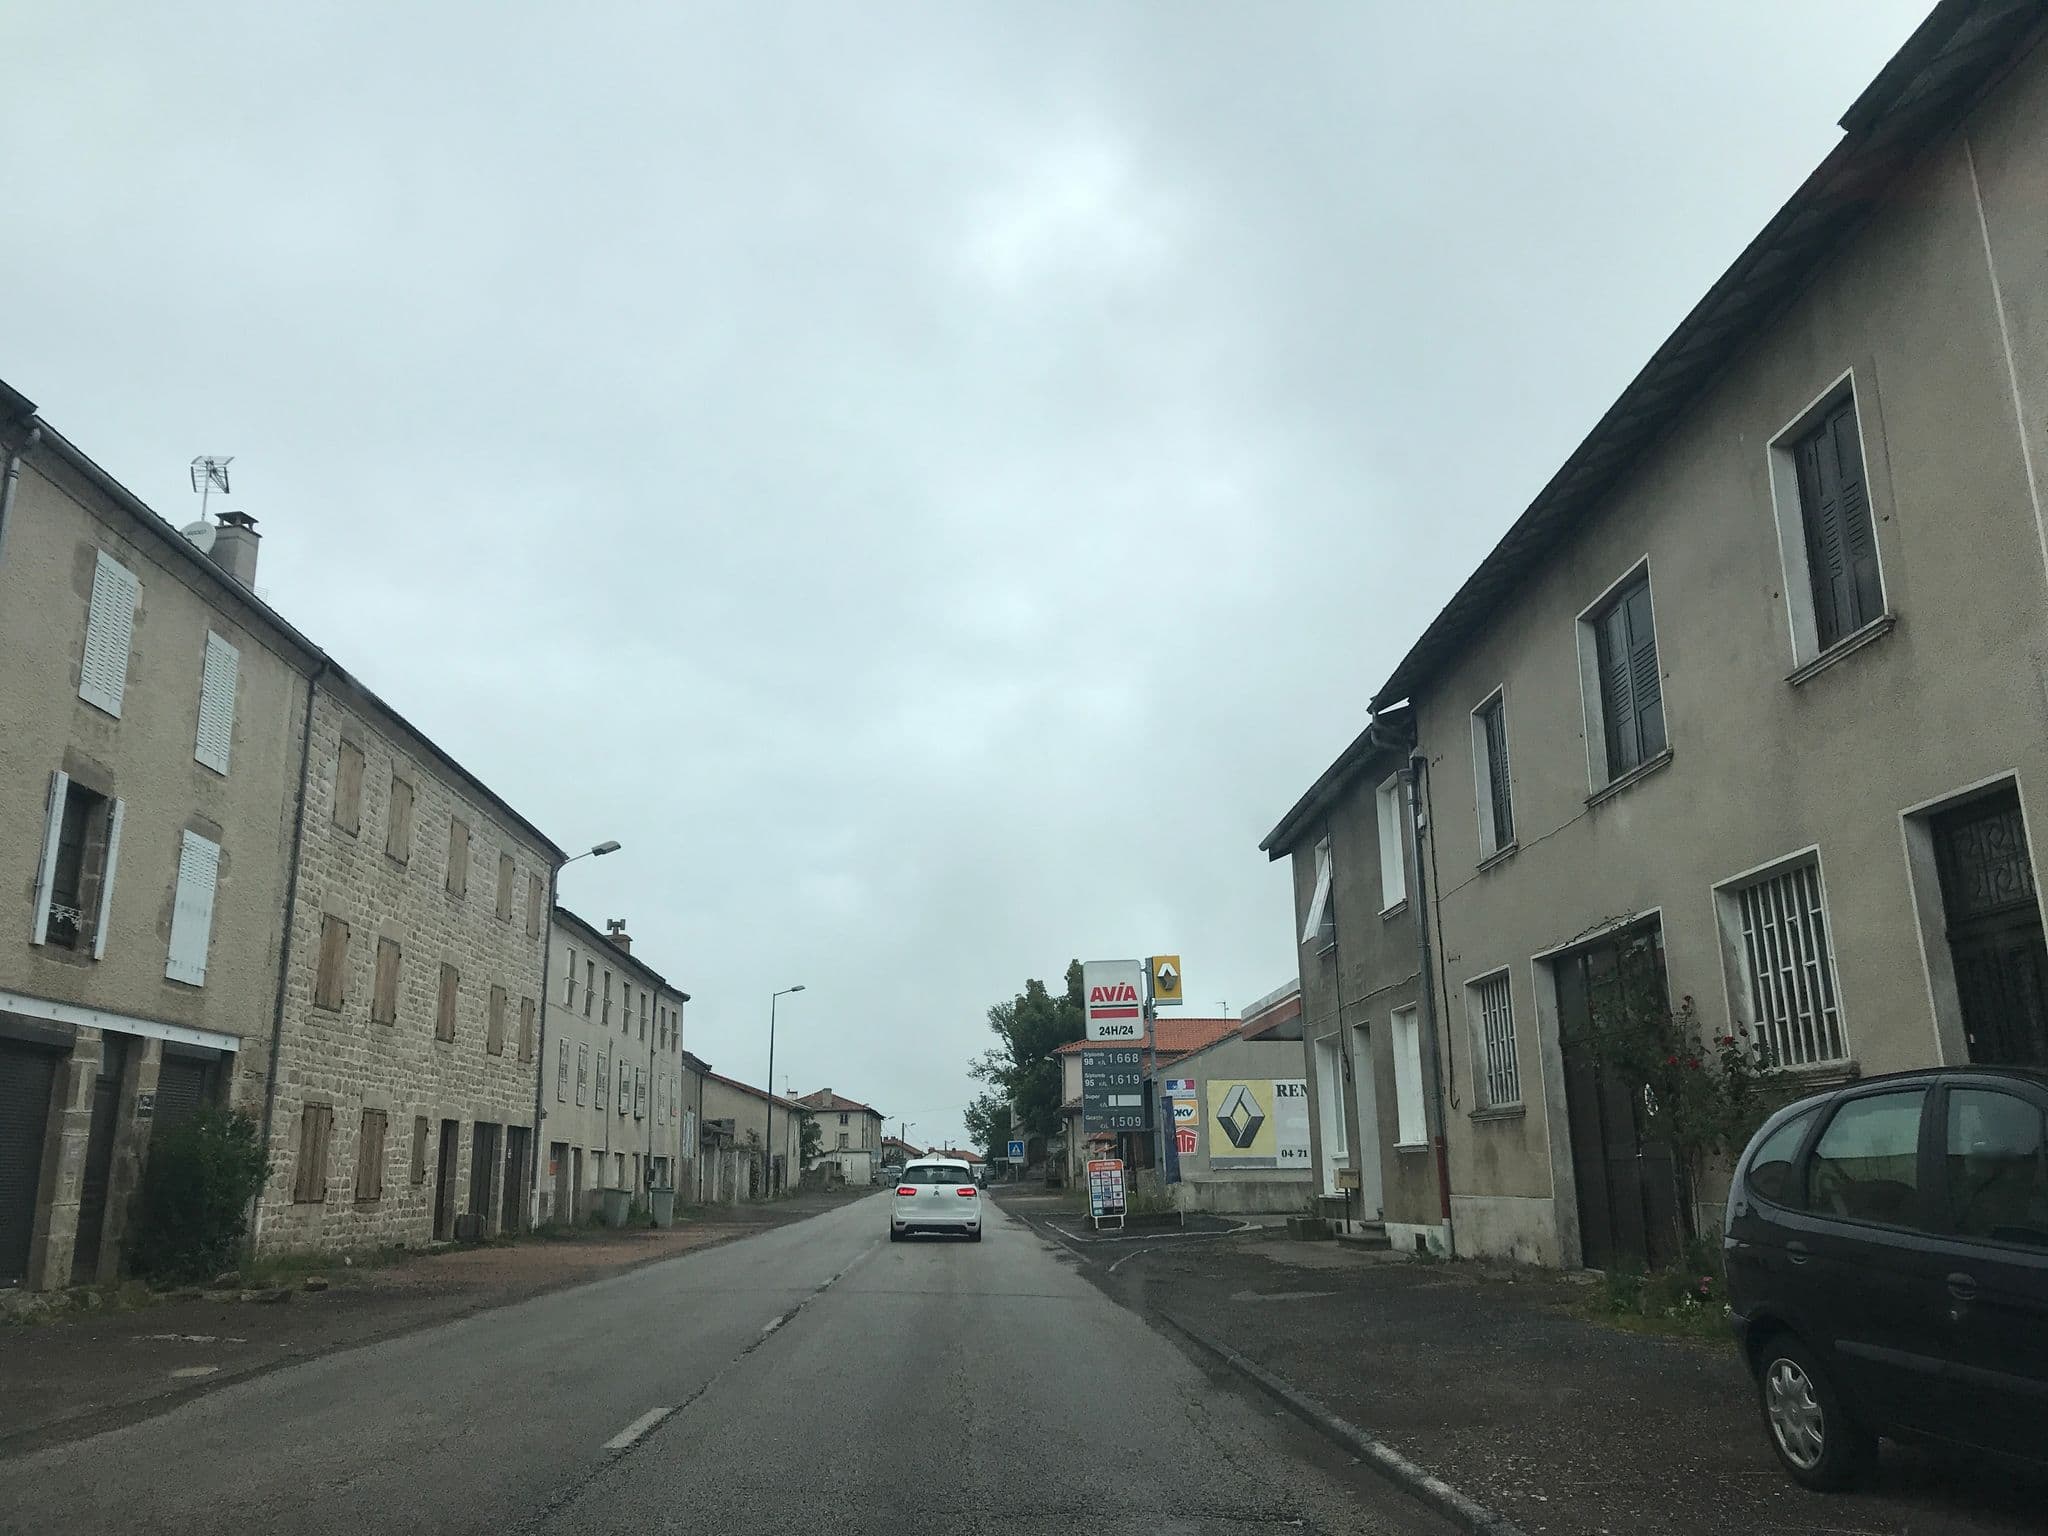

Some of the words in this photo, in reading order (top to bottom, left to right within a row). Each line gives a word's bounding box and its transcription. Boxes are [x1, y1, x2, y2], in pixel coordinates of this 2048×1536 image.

[1099, 1025, 1134, 1036] 24H/24
[1083, 1058, 1094, 1066] 98
[1108, 1053, 1139, 1064] 1.668
[1084, 1079, 1095, 1087] 95
[1109, 1074, 1140, 1085] 1.619
[1110, 1116, 1141, 1128] 1.509
[1281, 1149, 1294, 1158] 04
[1297, 1149, 1308, 1158] 71
